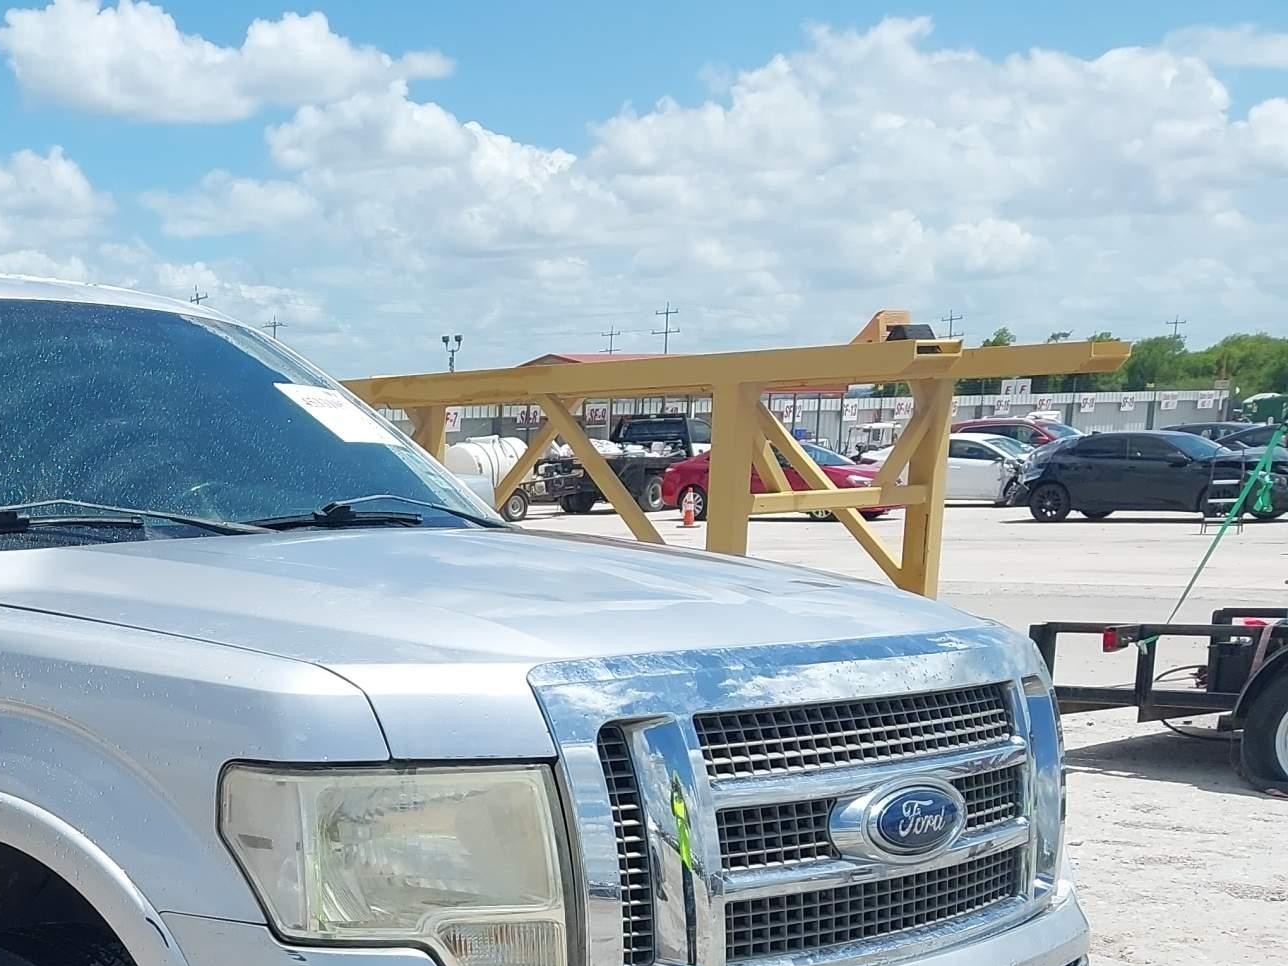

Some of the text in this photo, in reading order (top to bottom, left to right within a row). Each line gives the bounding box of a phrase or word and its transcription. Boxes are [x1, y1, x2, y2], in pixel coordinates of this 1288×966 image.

[1004, 385, 1012, 395] E
[1018, 384, 1028, 394] F
[898, 799, 946, 838] Ford
